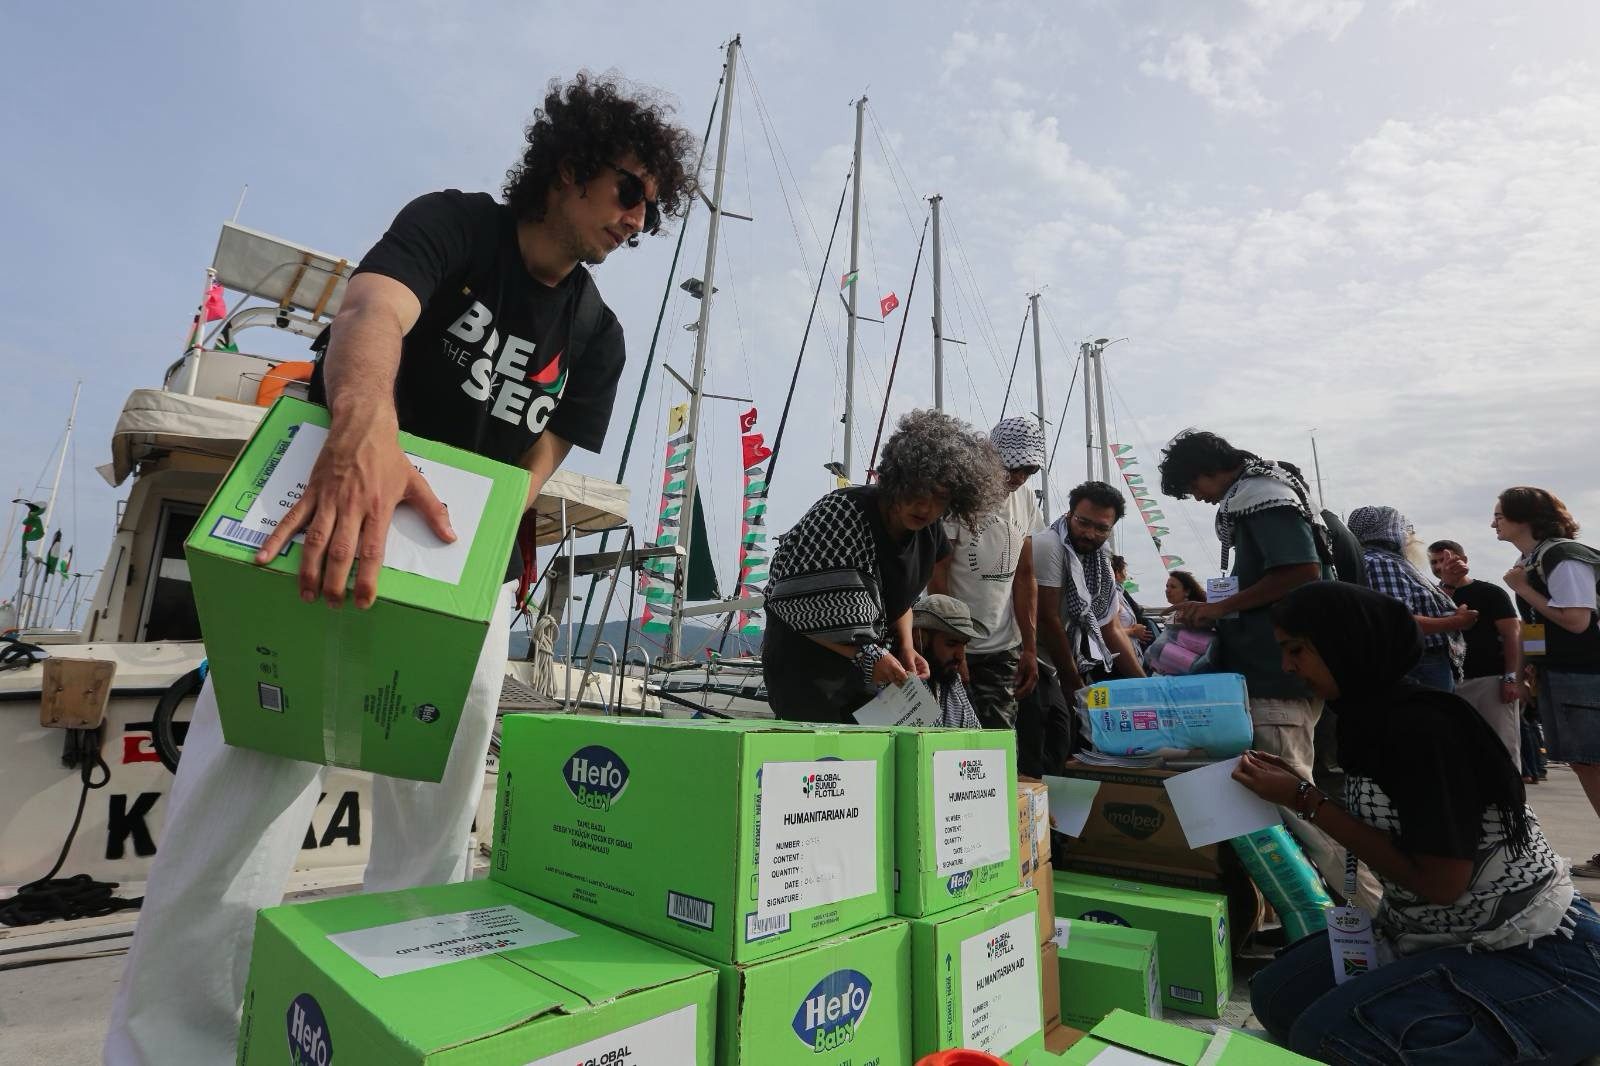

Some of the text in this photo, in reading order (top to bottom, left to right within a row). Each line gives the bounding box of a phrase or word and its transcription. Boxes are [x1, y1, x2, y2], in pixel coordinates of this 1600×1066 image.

[442, 338, 471, 367] THE
[572, 757, 622, 789] Hero
[815, 774, 841, 782] GLOBAL
[815, 782, 837, 790] SUMUD
[815, 789, 845, 798] FLOTILLA
[577, 785, 611, 812] Baby
[948, 790, 988, 802] HUMANITARIAN
[784, 807, 859, 826] HUMANITARIAN AID
[1108, 808, 1161, 829] molped
[776, 840, 800, 850] NUMBER
[773, 853, 799, 865] CONTENT
[771, 866, 800, 879] QUANTITY
[785, 880, 799, 890] DATE
[767, 893, 799, 907] SIGNATURE
[395, 927, 525, 955] HUMANITARIAN AID
[976, 957, 1025, 991] HUMANITARIAN AID
[805, 983, 864, 1031] Hero
[291, 1001, 326, 1066] Hero
[815, 1018, 855, 1053] Baby
